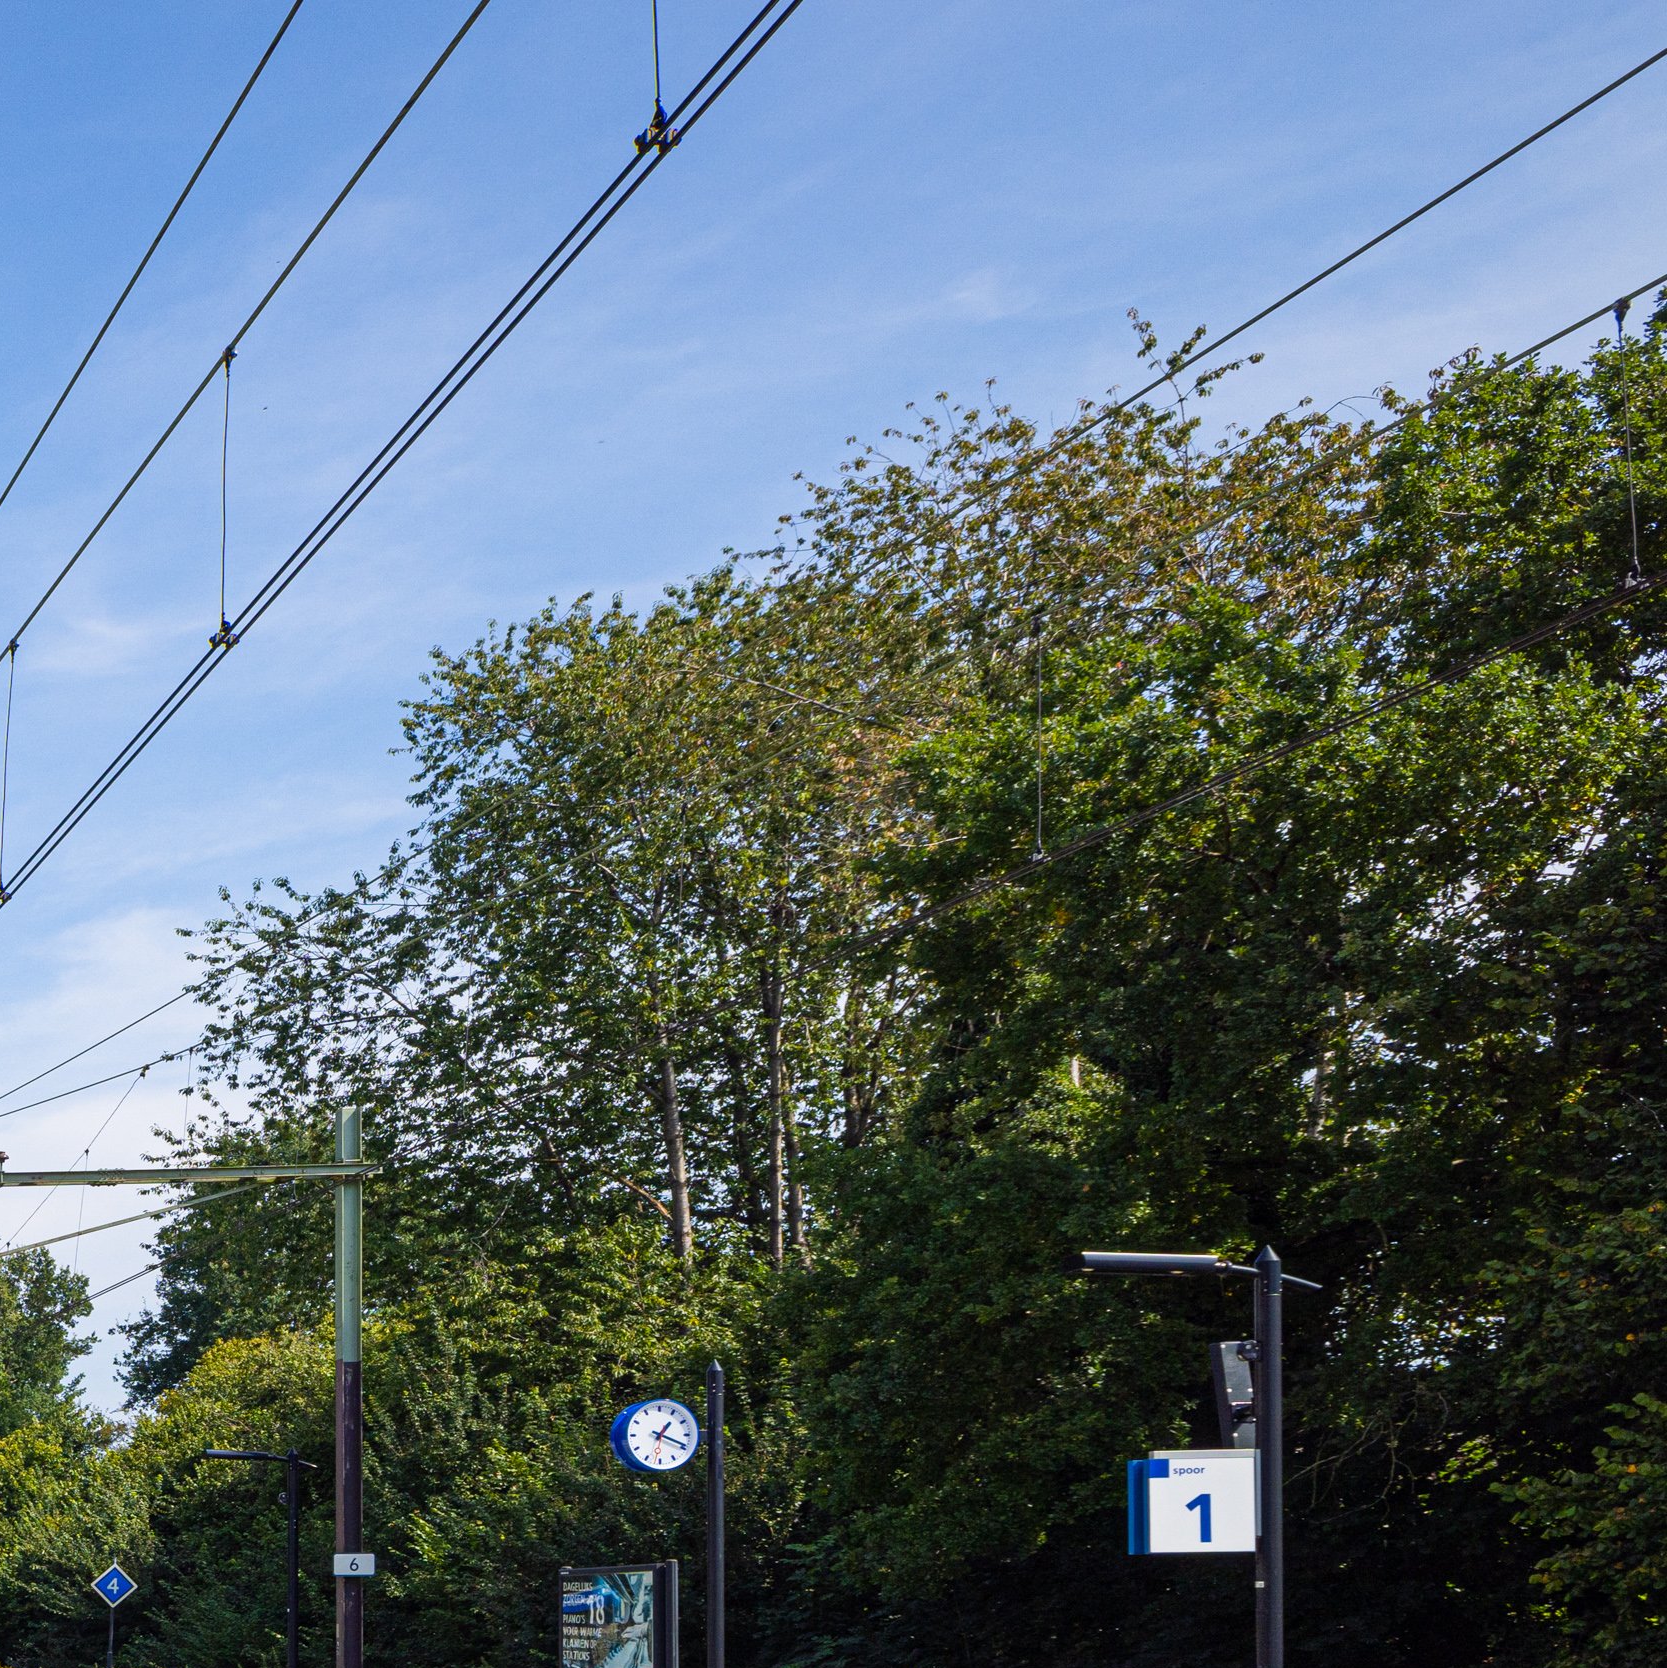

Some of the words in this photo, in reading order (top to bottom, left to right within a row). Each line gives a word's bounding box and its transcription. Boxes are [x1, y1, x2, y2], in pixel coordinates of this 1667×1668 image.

[1172, 1466, 1206, 1477] spoor
[1185, 1493, 1212, 1543] 1
[348, 1557, 360, 1572] 6
[106, 1577, 120, 1595] 4
[589, 1594, 605, 1625] 18
